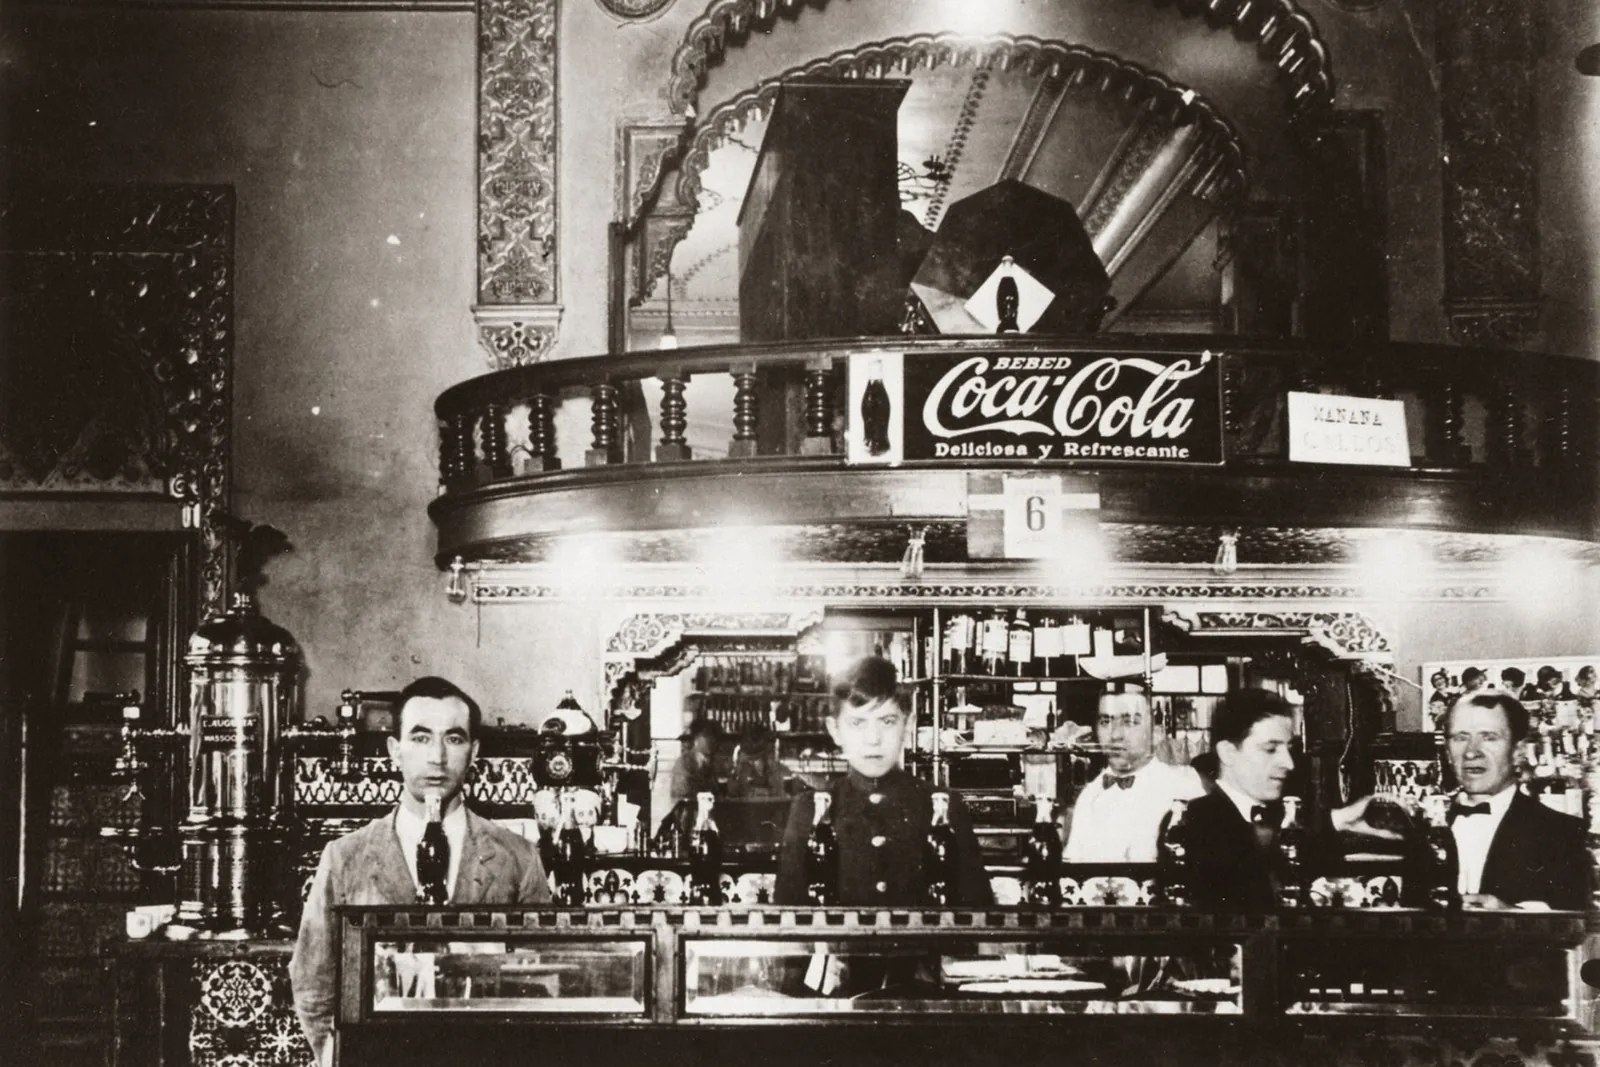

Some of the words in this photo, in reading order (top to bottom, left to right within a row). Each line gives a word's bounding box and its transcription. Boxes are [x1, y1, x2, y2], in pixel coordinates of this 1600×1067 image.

[993, 356, 1072, 370] BEBED
[923, 352, 1210, 438] Coca-Cola
[934, 441, 1028, 457] Deliciosa
[1038, 443, 1053, 460] y
[1063, 441, 1190, 459] Refrescante
[1025, 495, 1046, 532] 6
